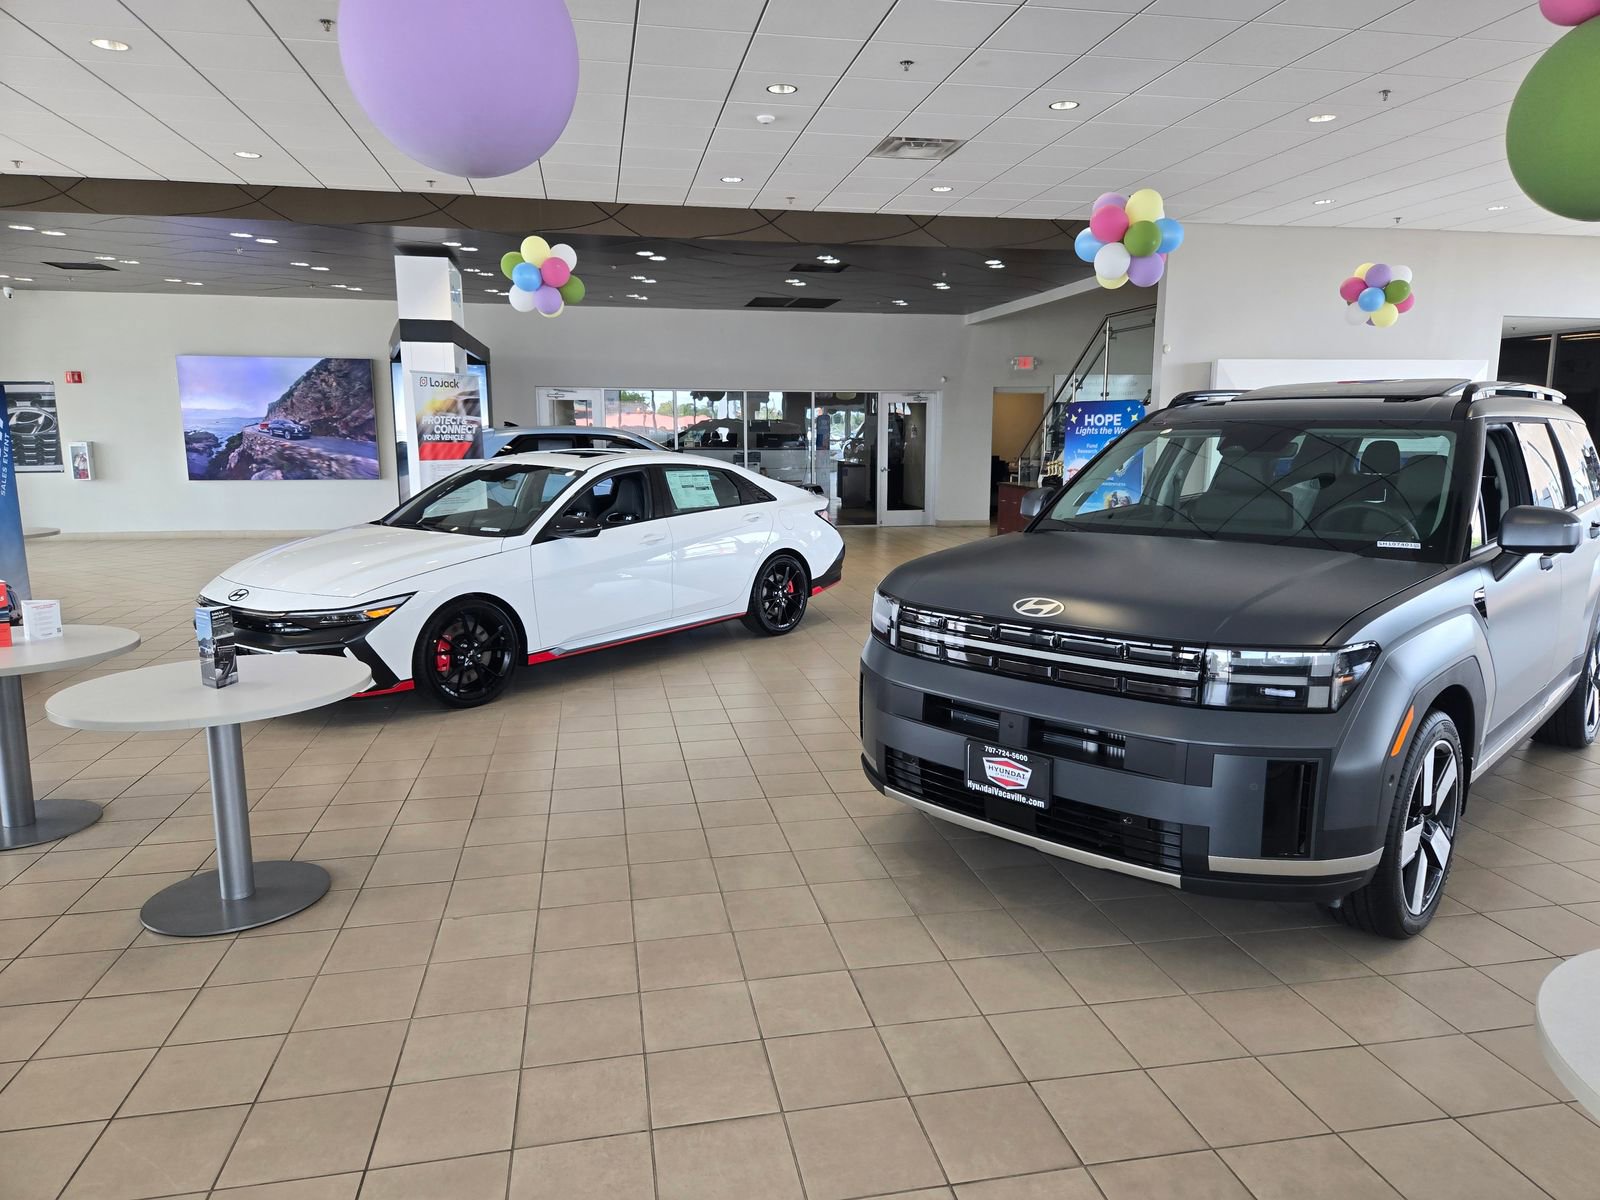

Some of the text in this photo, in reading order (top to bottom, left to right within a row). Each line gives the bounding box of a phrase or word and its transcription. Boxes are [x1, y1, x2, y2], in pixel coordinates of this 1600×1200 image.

[422, 416, 461, 425] PROTECT
[1084, 413, 1122, 426] HOPE
[434, 425, 478, 434] CONNECT
[1075, 427, 1128, 437] Lights the Wa
[984, 745, 1028, 762] 707-724-5600
[988, 765, 1026, 780] HYUNDAI
[967, 780, 1045, 809] HyundaiVacaville.com
